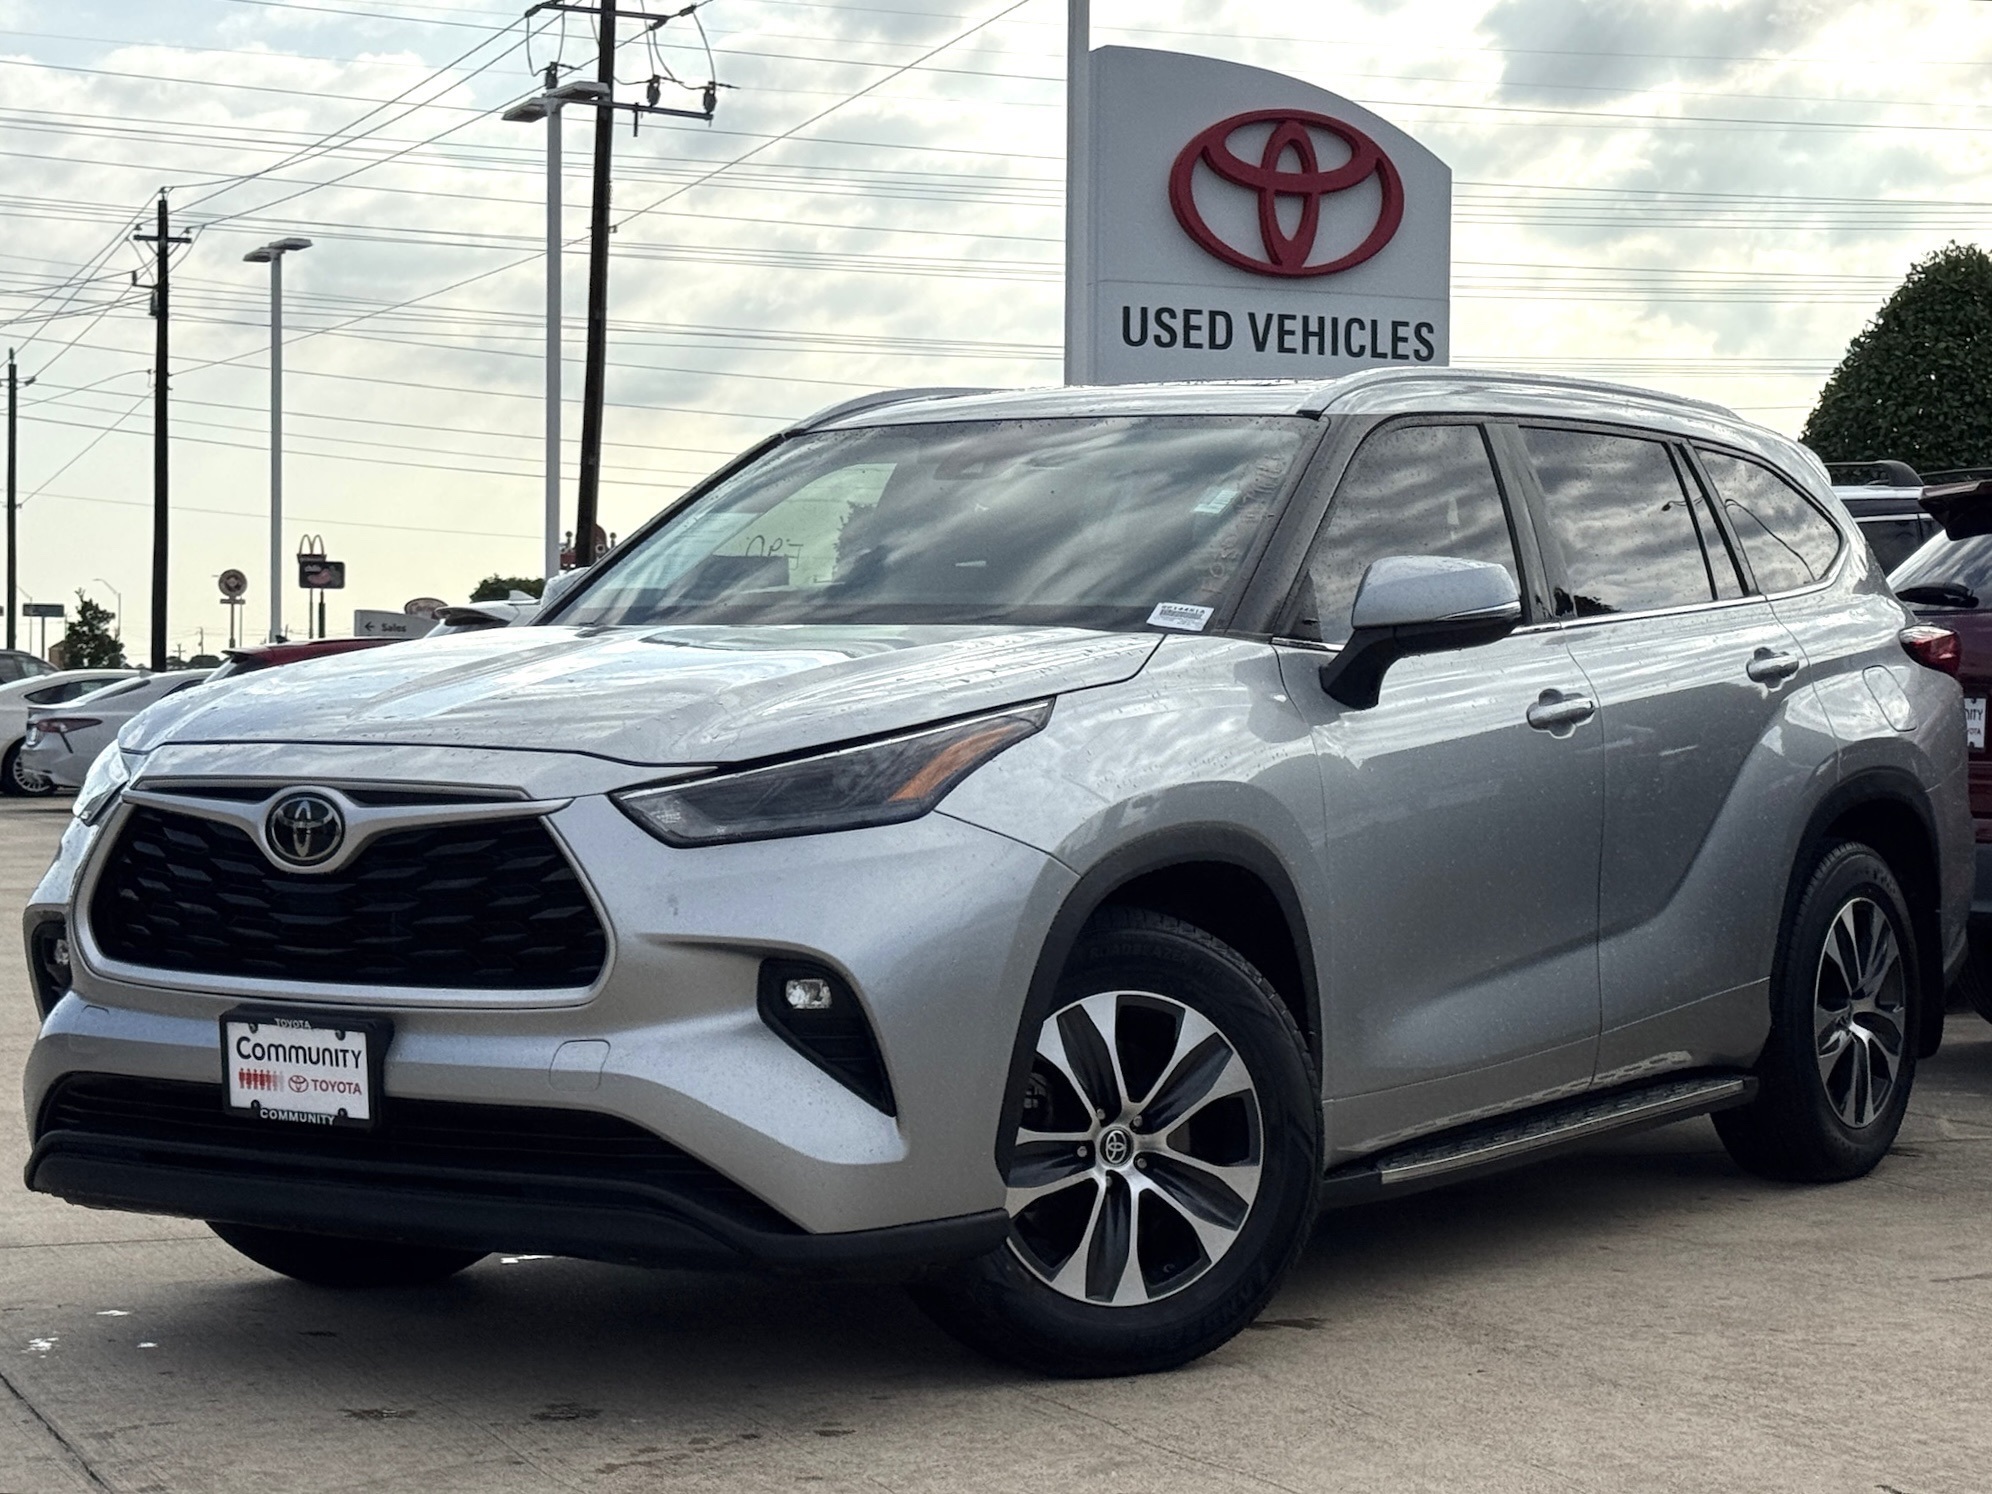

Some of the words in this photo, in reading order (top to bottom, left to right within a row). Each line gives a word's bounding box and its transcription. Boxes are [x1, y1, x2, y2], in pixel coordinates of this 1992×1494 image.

[1122, 306, 1233, 350] USED
[1247, 312, 1435, 362] VEHICLES
[381, 623, 406, 634] Sales
[274, 1017, 312, 1029] TOYOTA
[311, 1078, 362, 1096] TOYOTA
[259, 1107, 335, 1126] COMMUNITY
